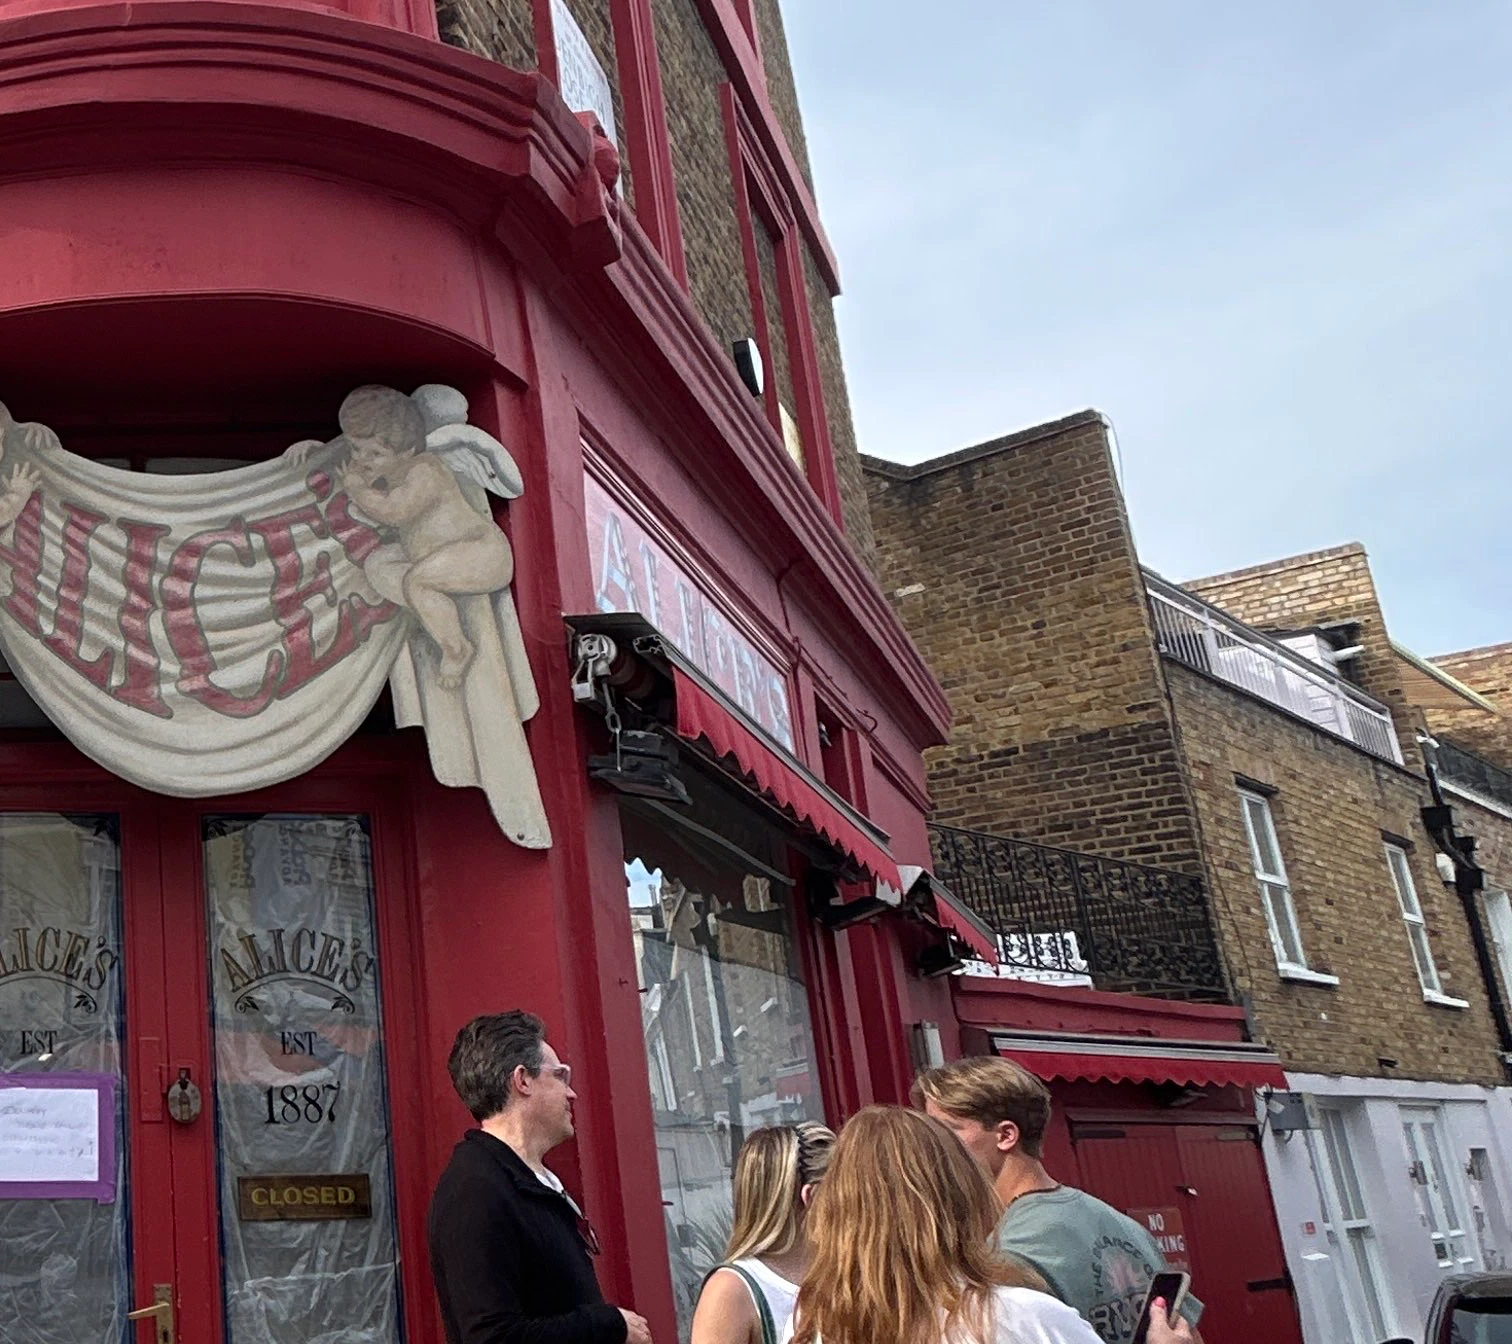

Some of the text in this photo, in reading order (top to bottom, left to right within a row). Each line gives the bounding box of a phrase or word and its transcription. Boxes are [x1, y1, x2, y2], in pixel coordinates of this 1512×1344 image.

[220, 927, 375, 994] ALICE'S
[20, 1030, 58, 1056] EST
[280, 1031, 318, 1056] EST
[264, 1081, 341, 1124] 1887
[251, 1186, 356, 1206] CLOSED
[1148, 1213, 1165, 1232] NO
[1157, 1234, 1185, 1253] KING
